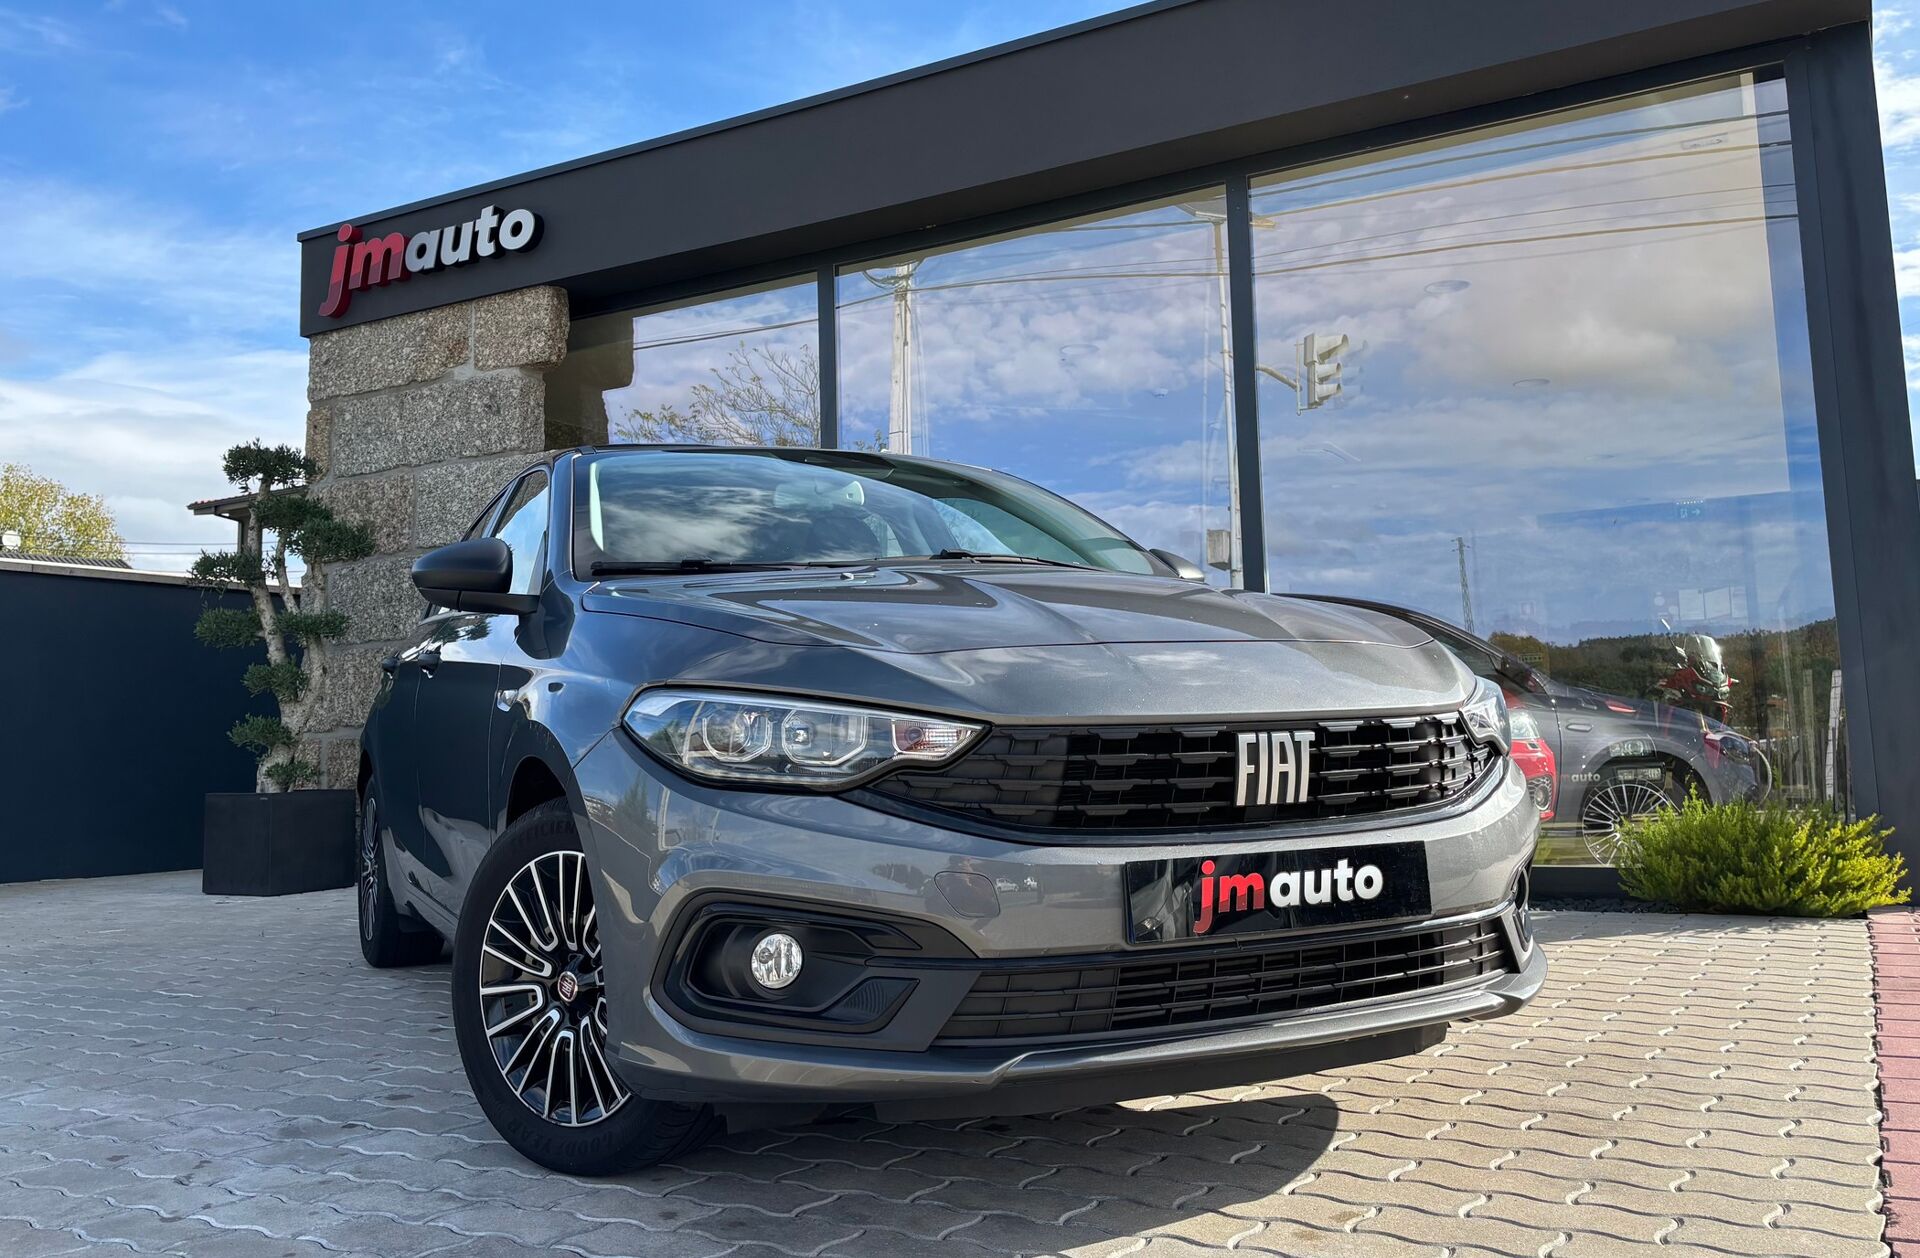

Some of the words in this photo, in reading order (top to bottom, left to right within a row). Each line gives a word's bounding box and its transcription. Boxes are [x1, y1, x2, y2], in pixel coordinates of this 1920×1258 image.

[319, 204, 539, 318] jmauto
[1235, 730, 1316, 806] FIAT
[1193, 858, 1384, 933] jmauto
